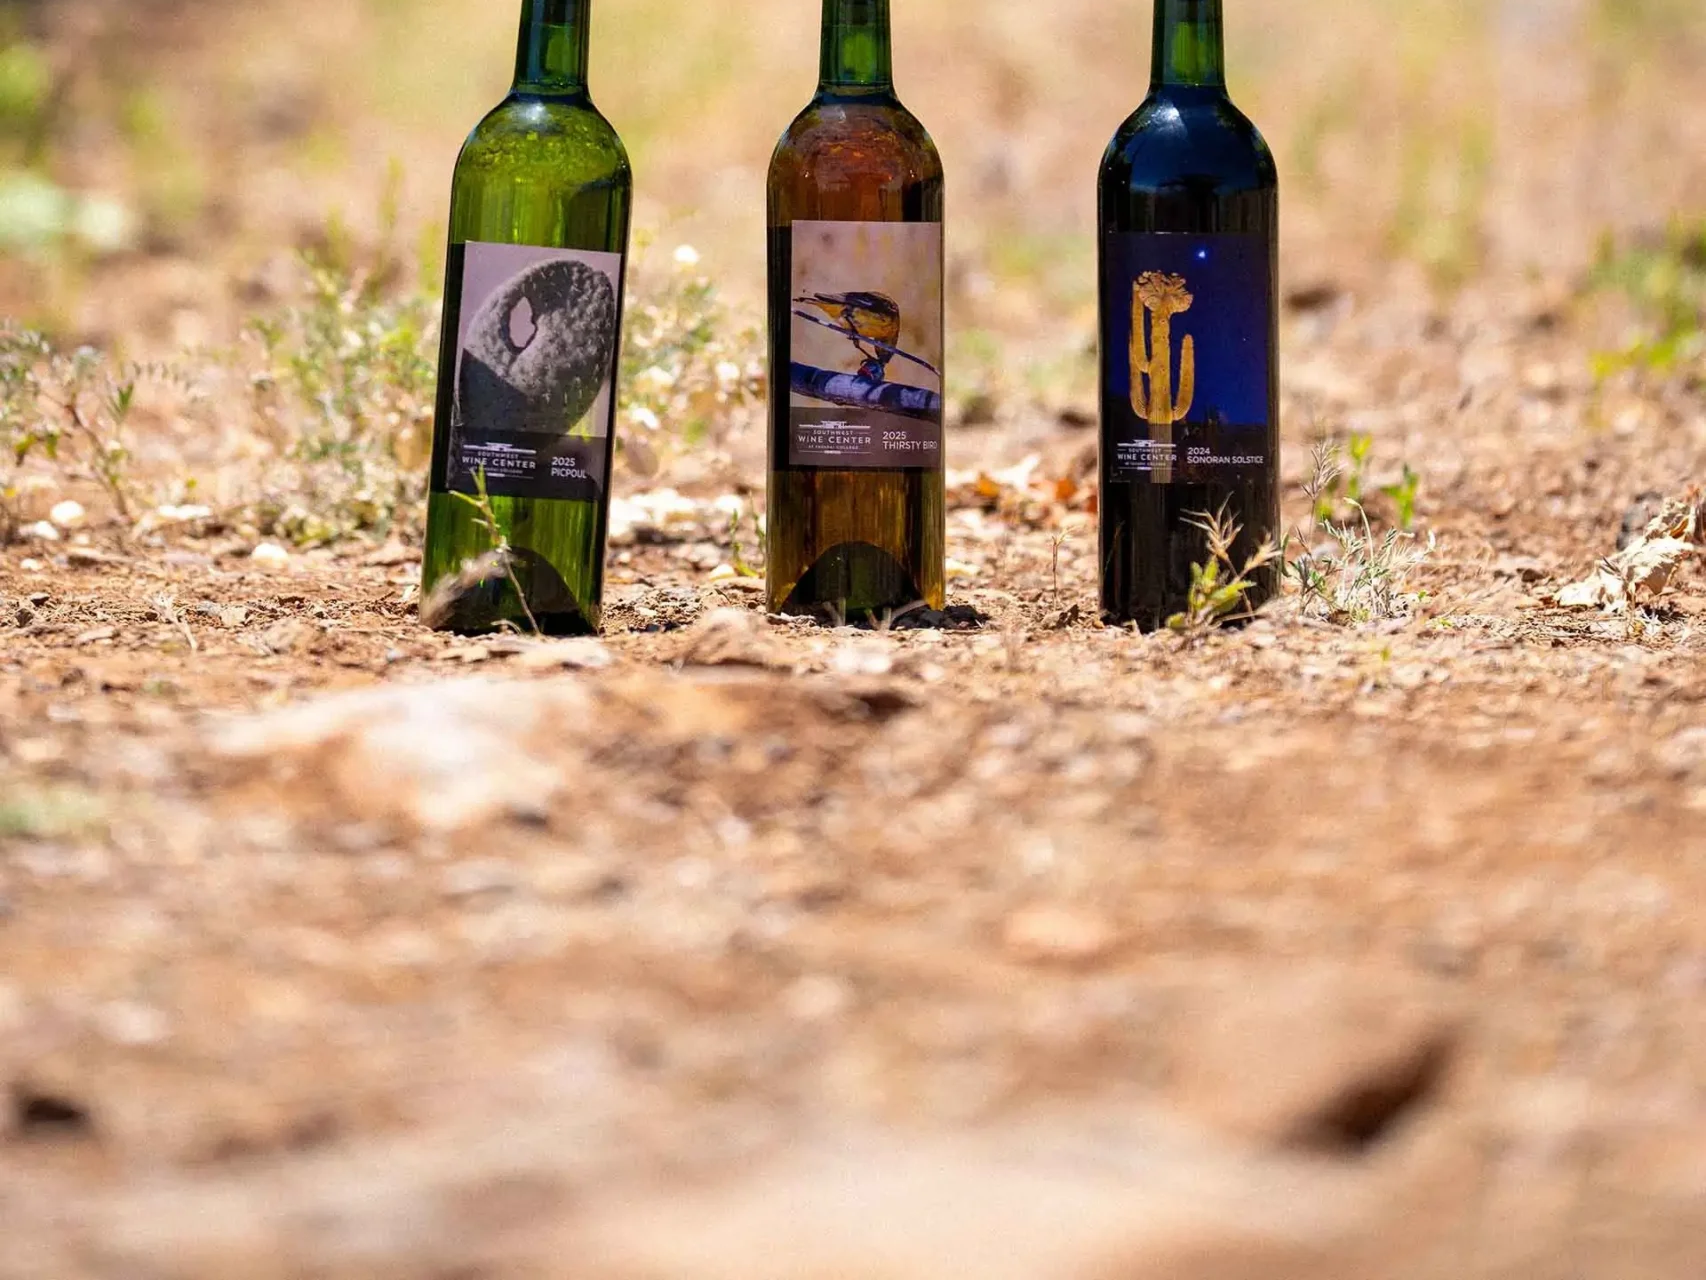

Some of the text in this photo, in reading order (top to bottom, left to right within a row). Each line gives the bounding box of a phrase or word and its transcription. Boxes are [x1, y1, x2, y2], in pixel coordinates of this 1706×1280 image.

[828, 436, 871, 444] CENTER
[882, 431, 907, 440] 2025
[882, 441, 938, 450] THIRSTY BIRD
[1187, 447, 1210, 455] 2024
[1117, 453, 1177, 461] WINE CENTER
[1187, 456, 1264, 464] SONORAN SOLSTICE
[462, 456, 536, 469] WINE CENTER
[552, 457, 576, 467] 2025
[551, 467, 587, 478] PICPOUL
